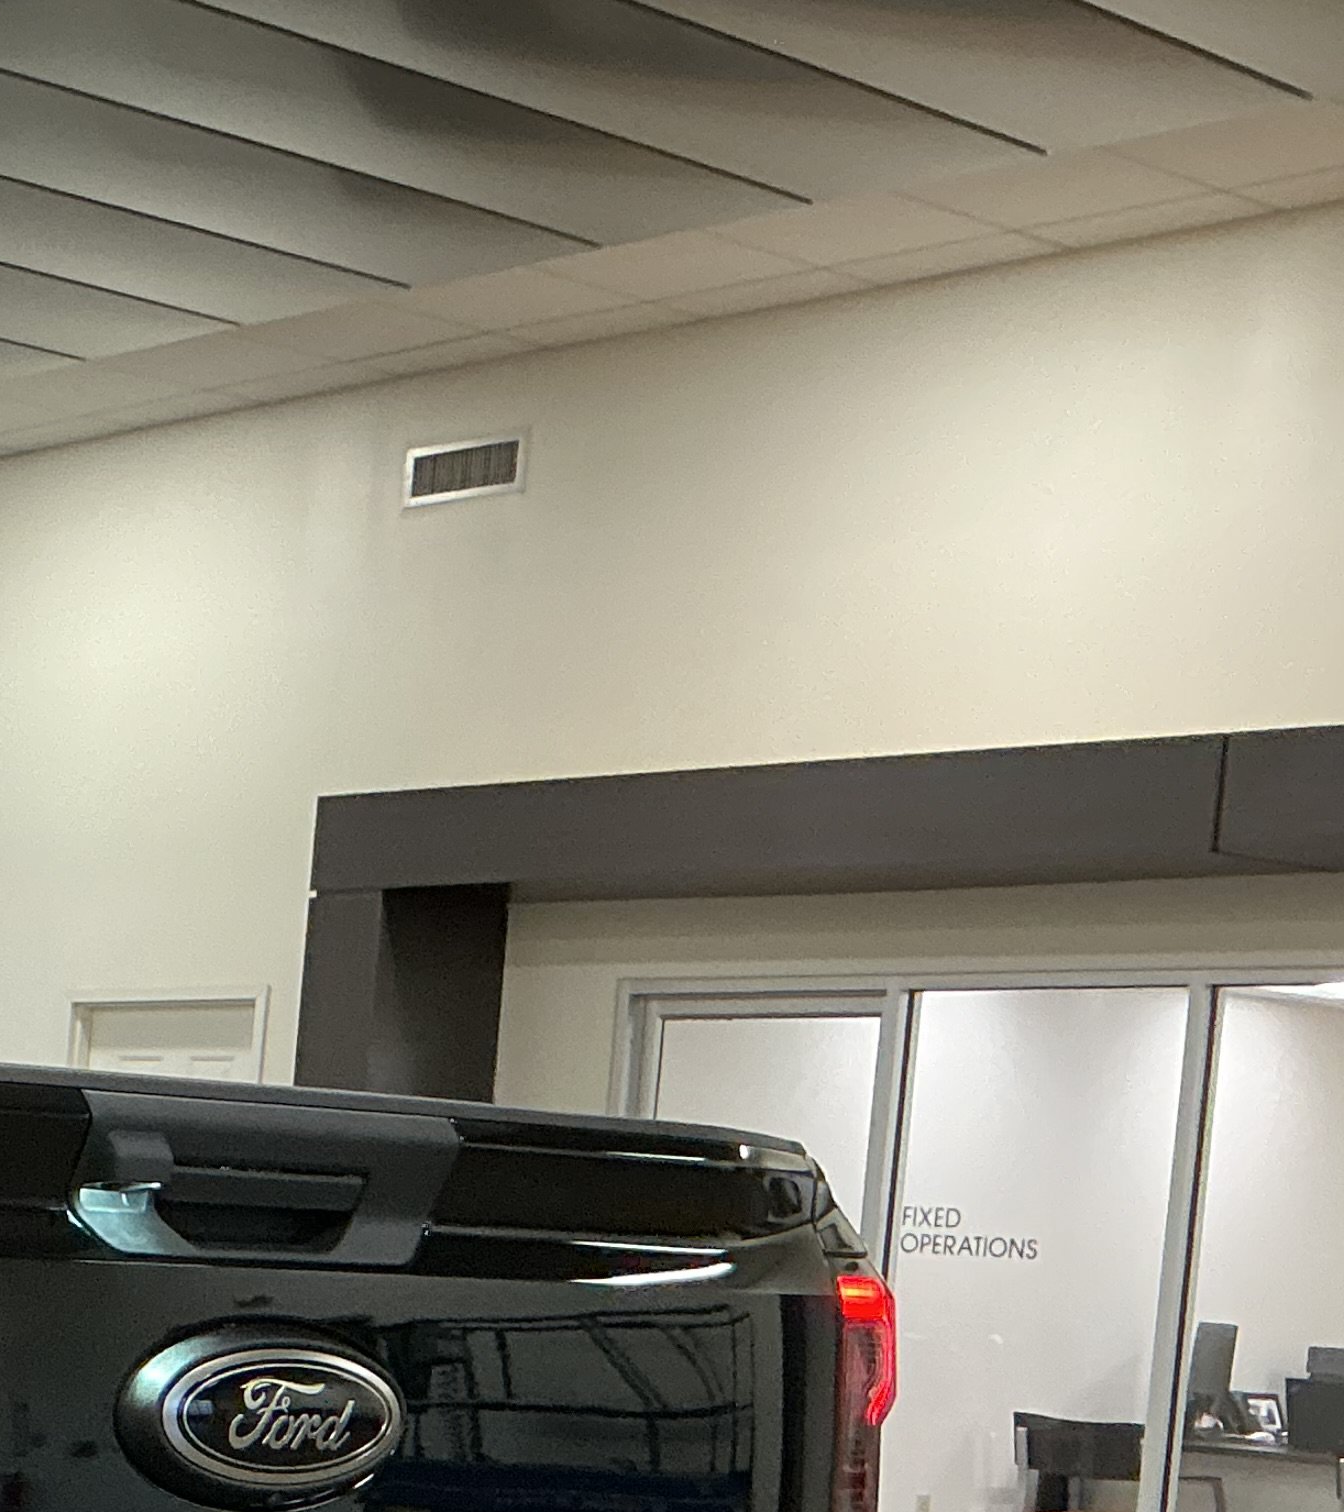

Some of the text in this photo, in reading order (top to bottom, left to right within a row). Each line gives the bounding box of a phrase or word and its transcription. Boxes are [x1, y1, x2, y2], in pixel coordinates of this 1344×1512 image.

[901, 1205, 962, 1229] FIXED
[899, 1232, 1039, 1261] OPERATIONS
[227, 1376, 356, 1451] Ford
